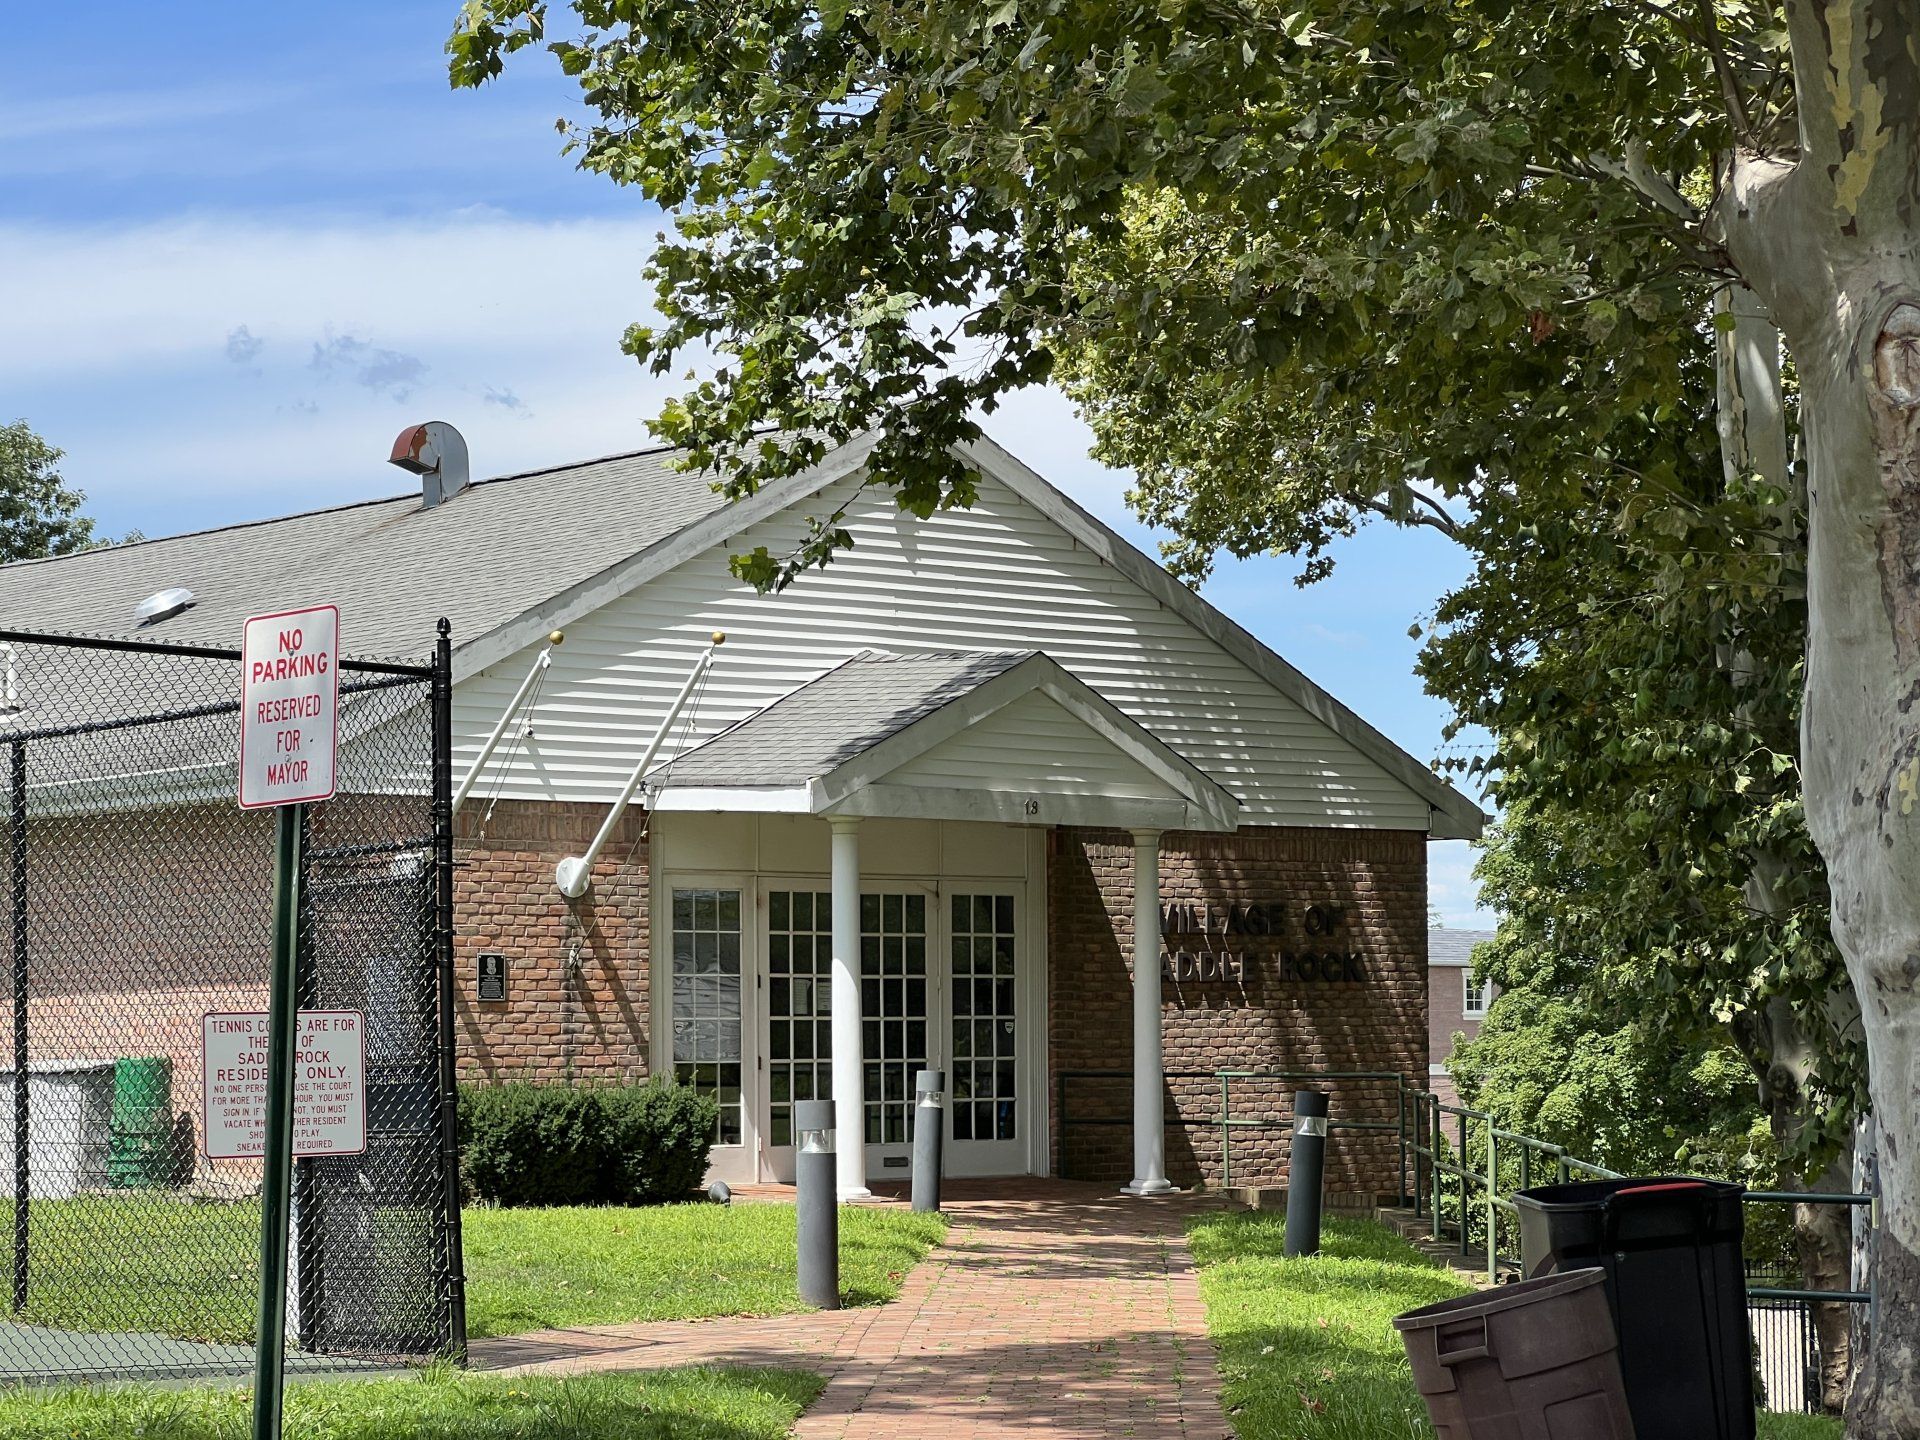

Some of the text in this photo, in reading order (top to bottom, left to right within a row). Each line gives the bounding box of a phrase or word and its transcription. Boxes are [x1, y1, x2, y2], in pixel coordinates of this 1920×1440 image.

[279, 629, 302, 652] NO
[252, 652, 328, 684] PARKING
[257, 694, 321, 724] RESERVED
[276, 729, 301, 753] FOR
[267, 760, 308, 787] MAYOR
[1025, 800, 1038, 815] 18
[1159, 903, 1346, 936] VILLAGE OF
[1159, 951, 1367, 982] ADDLE ROCK
[212, 1020, 252, 1033] TENNIS
[307, 1019, 328, 1032] ARE
[334, 1019, 355, 1031] FOR
[248, 1035, 315, 1048] THE OF
[296, 1051, 330, 1063] ROCK
[307, 1066, 351, 1079] ONLY.
[214, 1085, 224, 1093] NO
[228, 1085, 242, 1093] ONE
[295, 1083, 309, 1091] USE
[312, 1082, 326, 1091] THE
[329, 1081, 352, 1090] COURT
[212, 1097, 227, 1105] FOR
[230, 1096, 250, 1104] MORE
[319, 1094, 333, 1102] YOU
[335, 1093, 354, 1101] MUST
[223, 1108, 240, 1117] SIGN
[254, 1108, 260, 1116] IF
[311, 1105, 326, 1114] YOU
[328, 1105, 347, 1113] MUST
[224, 1119, 252, 1128] VACATE
[313, 1116, 347, 1126] RESIDENT
[297, 1140, 333, 1149] REQUIRED
